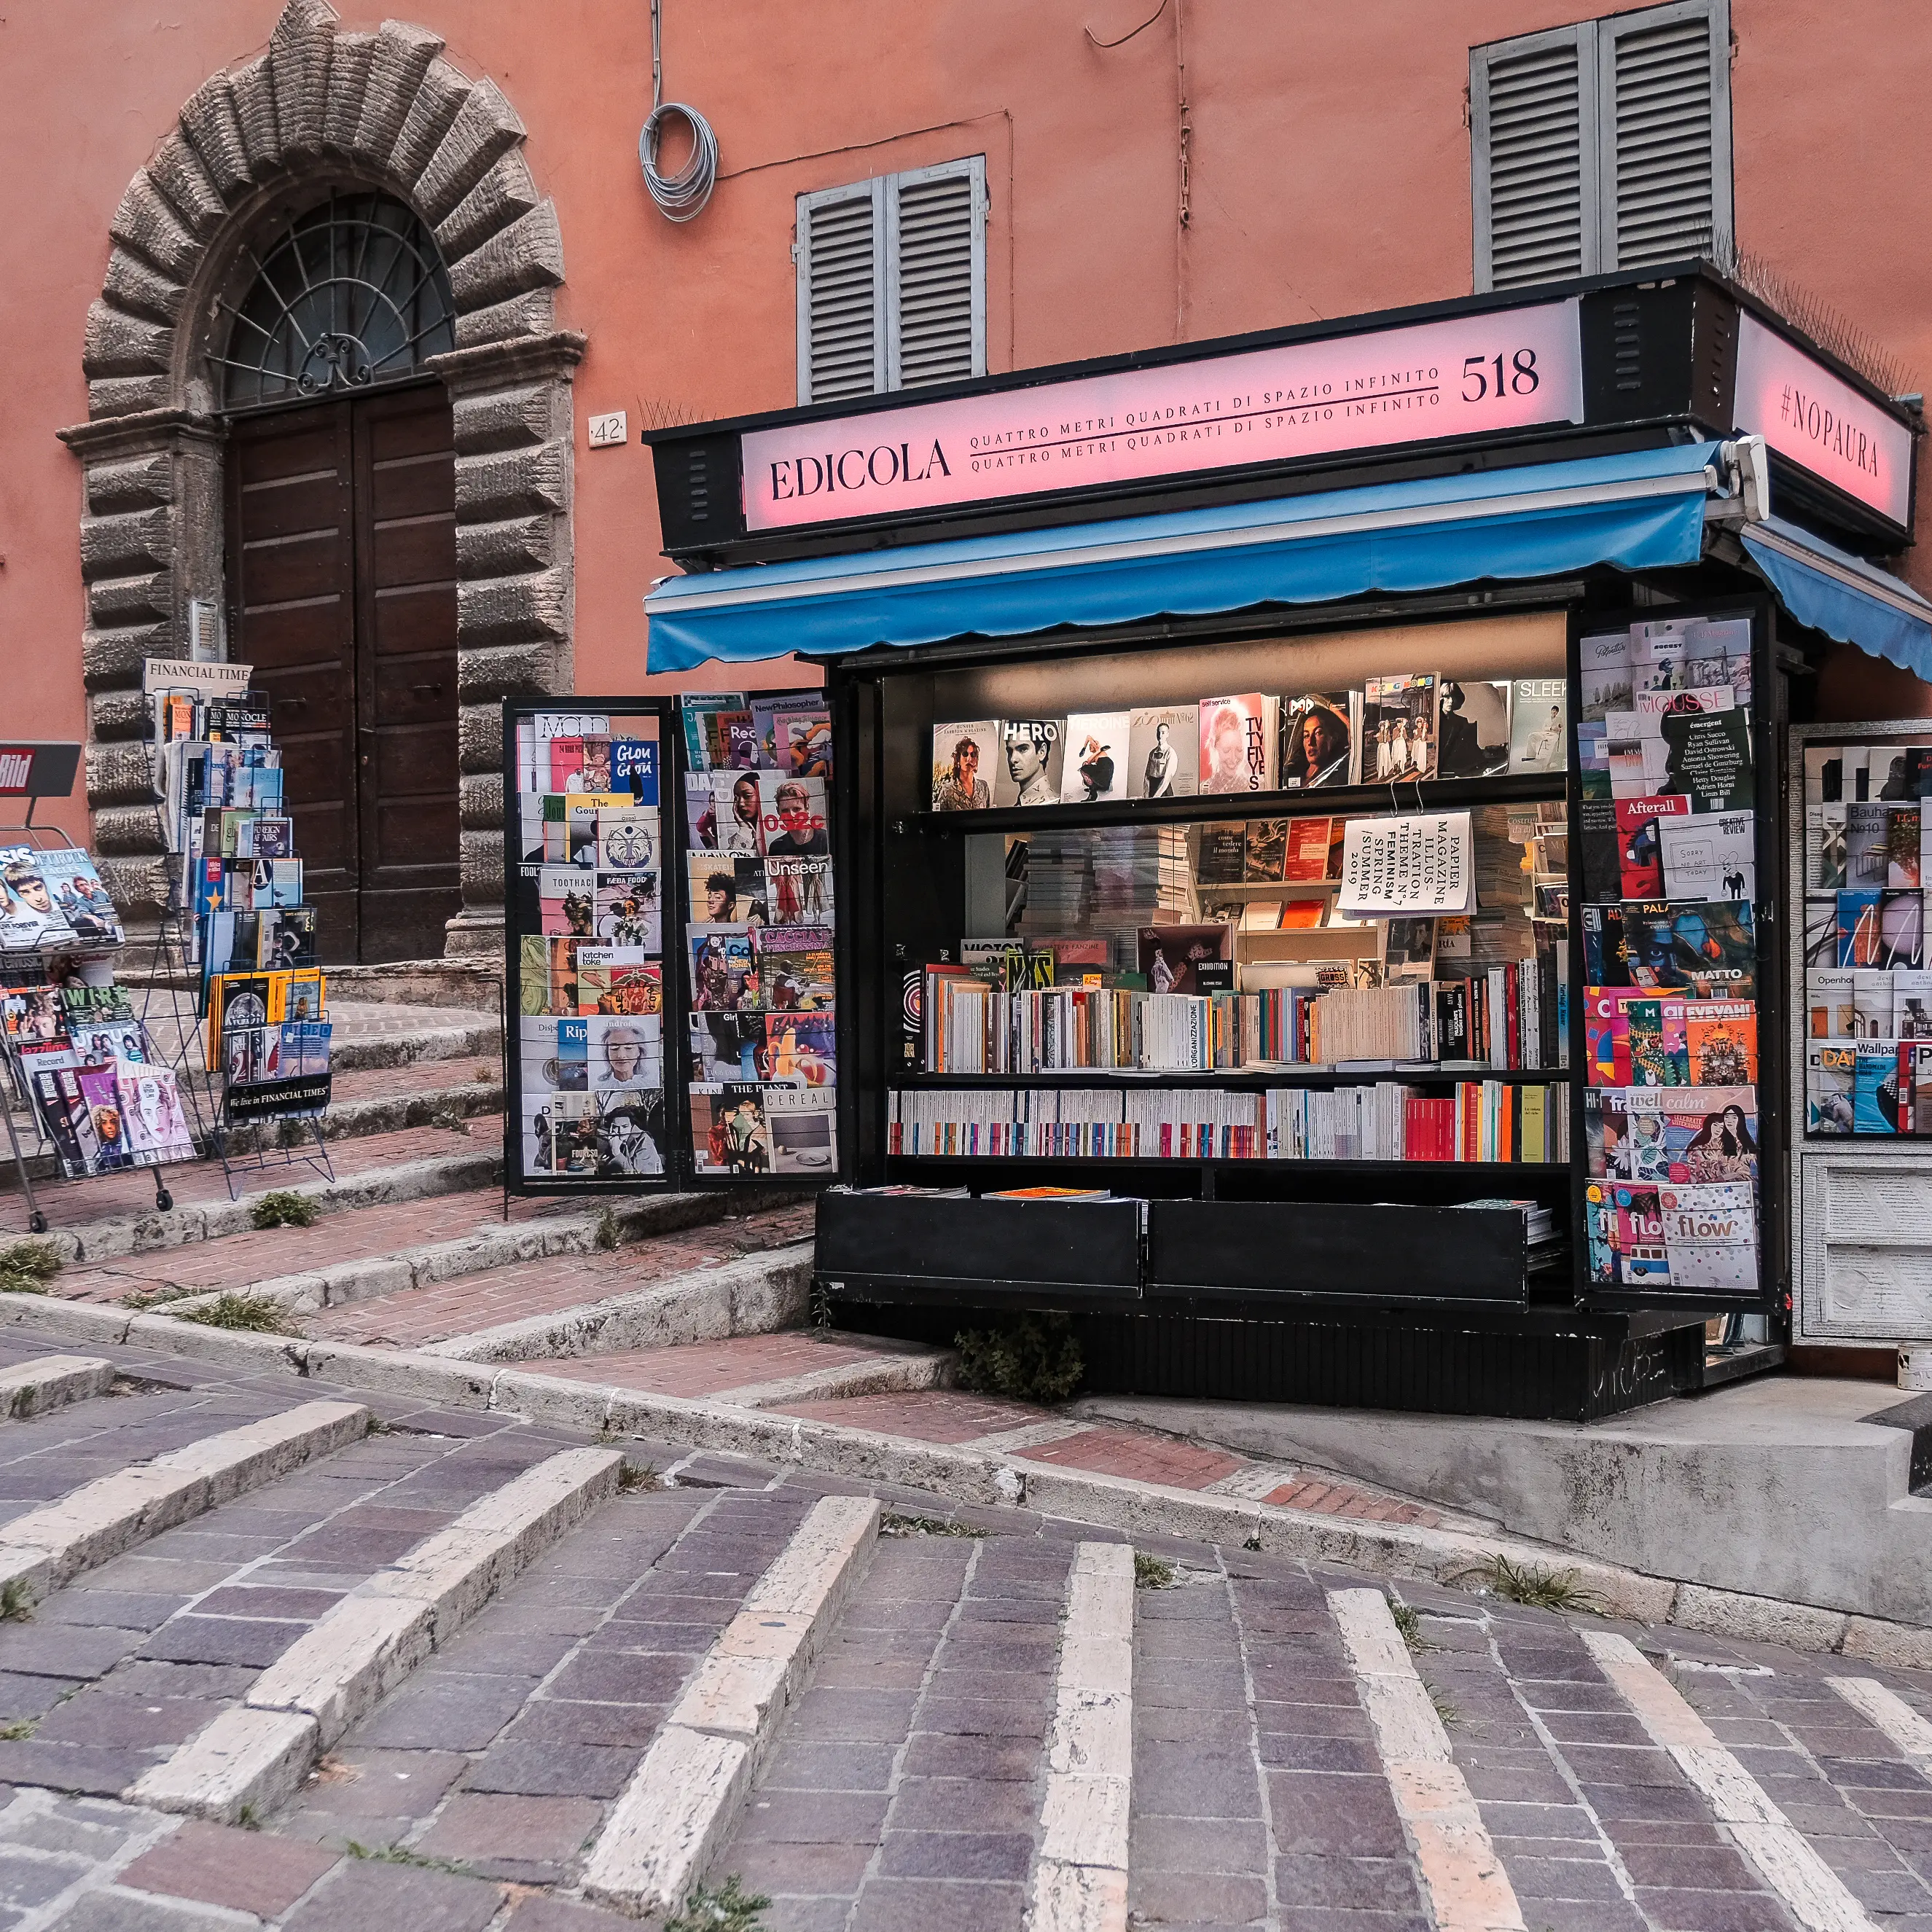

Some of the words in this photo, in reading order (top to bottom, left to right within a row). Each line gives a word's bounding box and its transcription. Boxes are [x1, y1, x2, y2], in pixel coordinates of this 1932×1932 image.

[1462, 348, 1539, 402] 518
[970, 426, 1049, 449] QUATTRO
[1060, 416, 1115, 435] METRI
[1126, 400, 1221, 427] QUADRATI
[1233, 395, 1251, 408] DI
[1264, 384, 1332, 404] SPAZIO
[1345, 367, 1439, 392] INFINITO
[594, 418, 619, 441] 42
[971, 447, 1050, 472] QUATTRO
[1061, 437, 1116, 459] METRI
[1127, 425, 1222, 451] QUADRATI
[1235, 421, 1253, 434] DI
[1265, 409, 1333, 429] SPAZIO
[1346, 394, 1440, 418] INFINITO
[1781, 384, 1877, 477] #NOPAURA
[770, 439, 951, 501] EDICOLA
[150, 664, 215, 678] FINANCIAL
[218, 668, 250, 681] TIME
[755, 700, 819, 712] NewPhilosopher
[1289, 697, 1315, 716] POP
[1640, 690, 1726, 713] MOUSSE
[1003, 723, 1057, 742] HERO
[1071, 716, 1130, 730] HEROINE
[591, 799, 609, 807] The
[1627, 799, 1675, 815] Afterall
[764, 812, 824, 832] 032c
[1719, 817, 1745, 826] CREATIVE
[1723, 825, 1745, 834] REVIEW
[254, 834, 278, 842] AFAIRS
[1399, 823, 1410, 878] THEME
[1680, 849, 1704, 859] SORRY
[767, 861, 827, 876] Unseen
[1348, 853, 1358, 885] 2019
[1358, 830, 1373, 901] /SUMMER
[1372, 838, 1384, 894] SPRING
[1384, 832, 1396, 899] FEMINISM
[1409, 829, 1422, 899] TRATION
[1424, 837, 1434, 891] ILLUS-
[1434, 821, 1448, 904] MAGAZINE
[1449, 837, 1460, 889] PAPIER
[13, 920, 39, 928] FOREVER
[765, 931, 818, 943] CACCIA
[582, 958, 601, 966] toke
[583, 951, 614, 960] kitchen
[1691, 969, 1743, 981] MATTO
[67, 986, 130, 1005] WIRE
[283, 1022, 333, 1038] WIRED
[566, 1026, 587, 1041] Rip
[1190, 1004, 1198, 1068] L'ORGANIZZAZIONE
[261, 1090, 302, 1103] FINANCIAL
[302, 1087, 326, 1097] TIMES
[732, 1085, 754, 1093] THE
[767, 1093, 829, 1106] CEREAL
[1666, 1093, 1705, 1109] calm
[1678, 1215, 1738, 1237] flow
